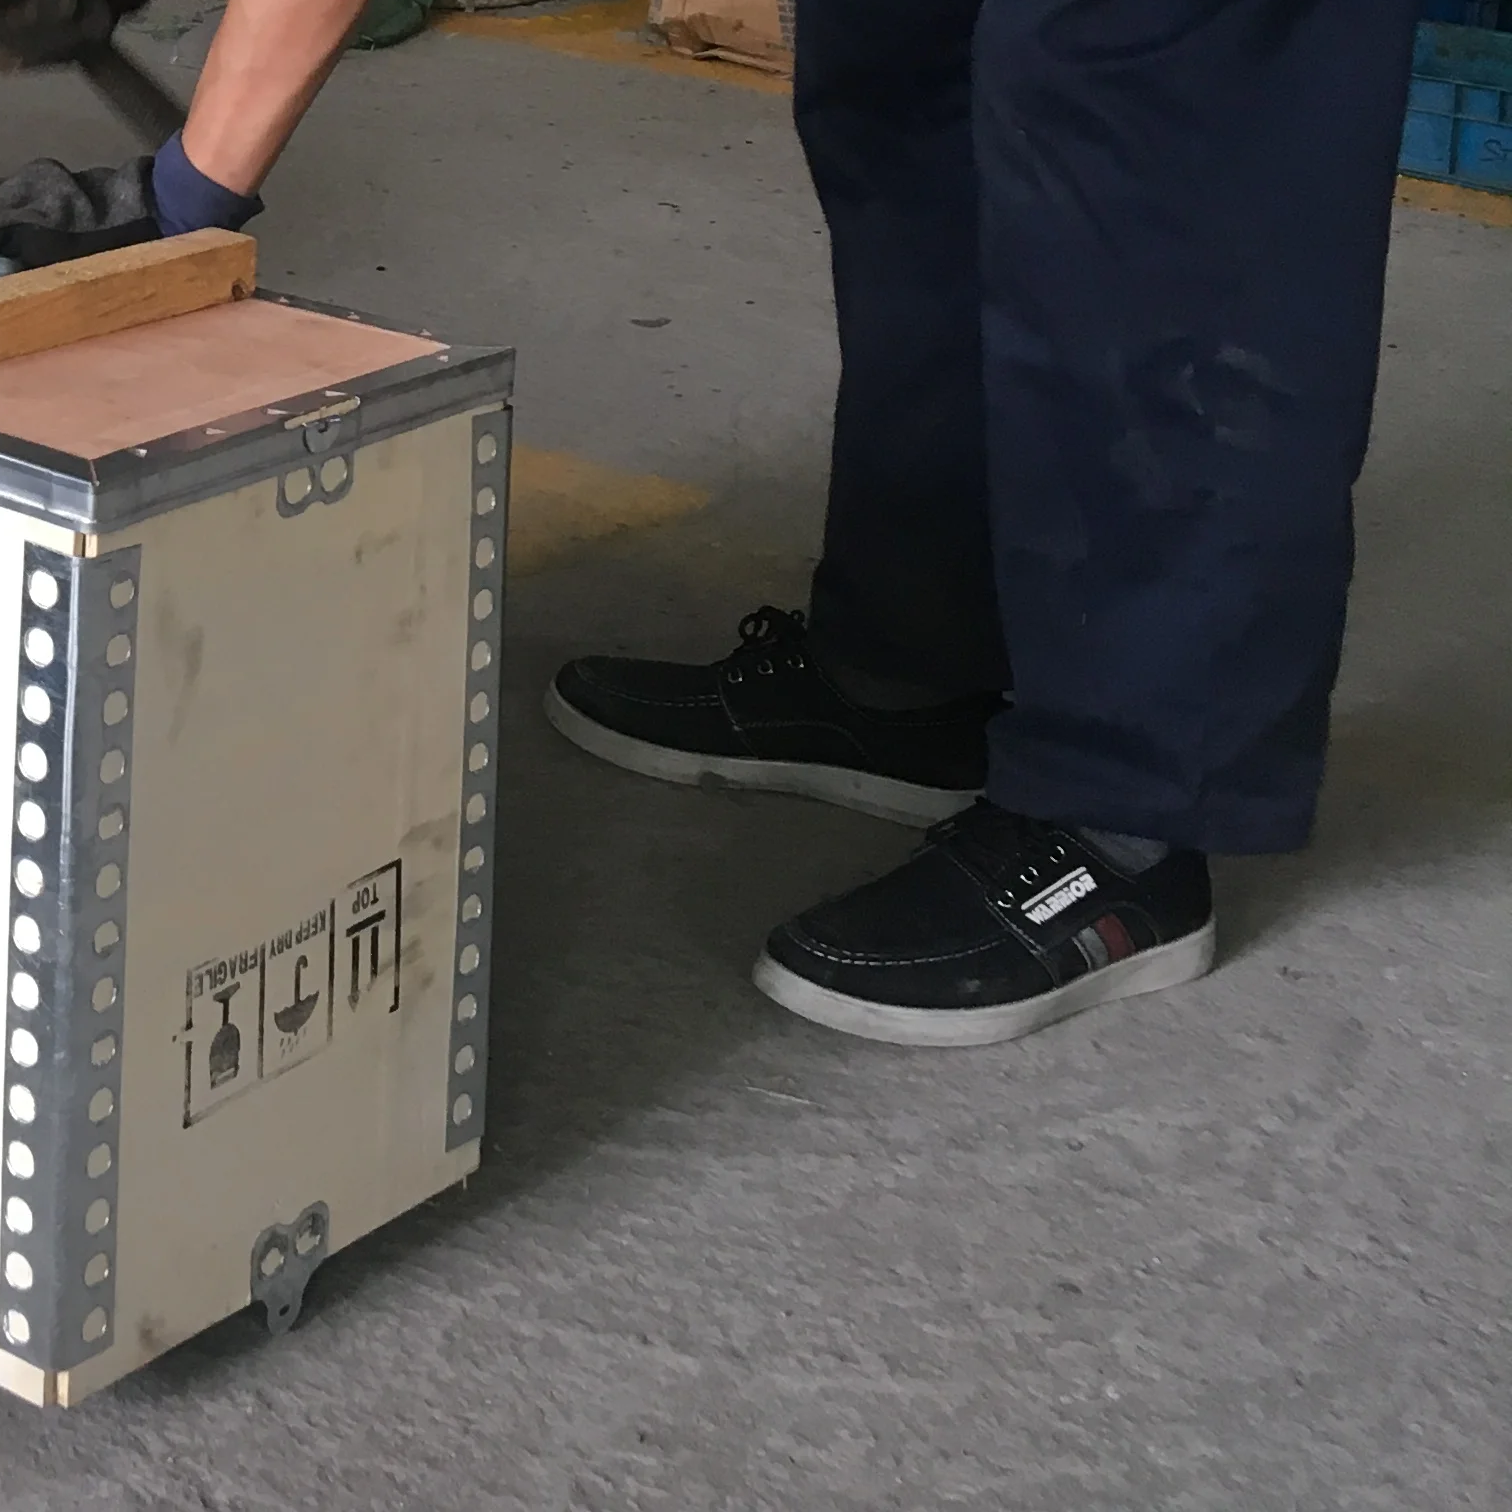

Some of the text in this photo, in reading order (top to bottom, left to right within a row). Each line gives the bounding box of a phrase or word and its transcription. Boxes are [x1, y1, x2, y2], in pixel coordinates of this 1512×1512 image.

[351, 881, 380, 915] TOP
[268, 908, 327, 961] KEEP DRY
[193, 947, 259, 999] FRAGILE
